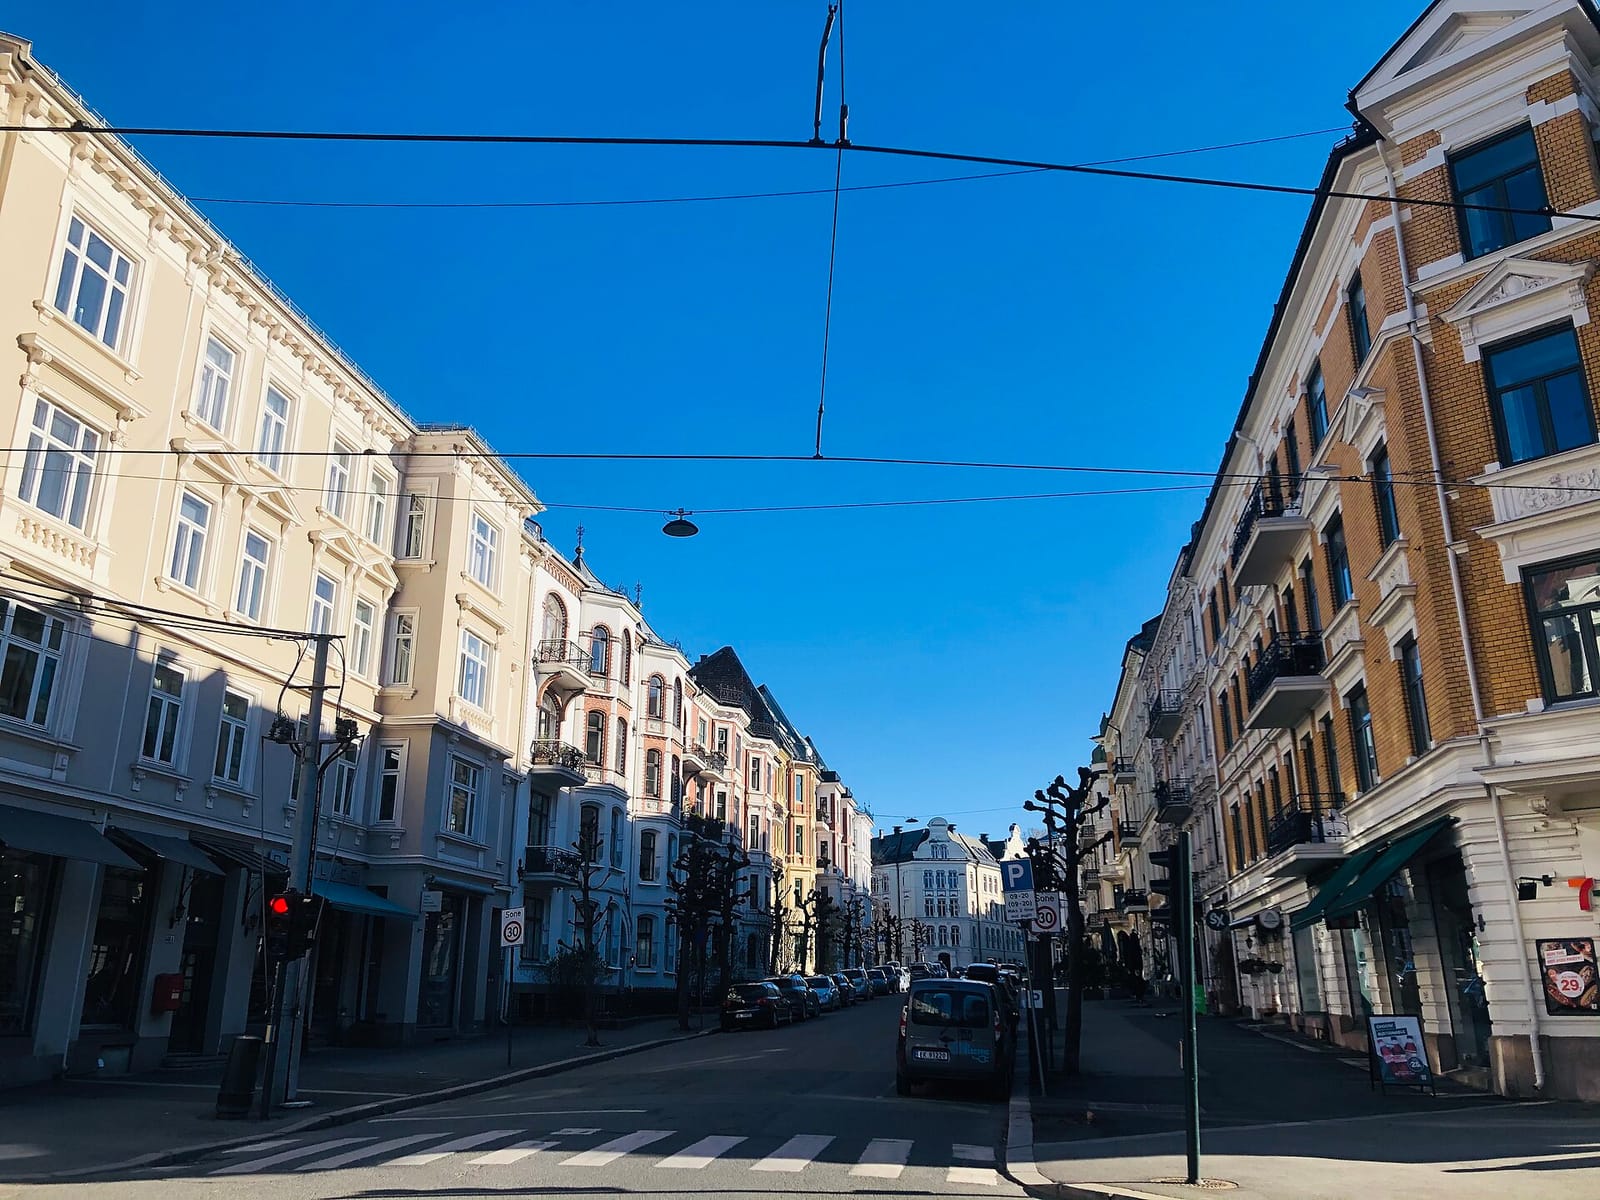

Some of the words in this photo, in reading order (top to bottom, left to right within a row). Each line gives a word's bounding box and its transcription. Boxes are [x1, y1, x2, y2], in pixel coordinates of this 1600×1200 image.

[1007, 863, 1025, 888] P
[1035, 894, 1054, 902] Sone
[505, 911, 521, 919] Sone
[1038, 912, 1053, 923] 30
[507, 926, 518, 938] 30
